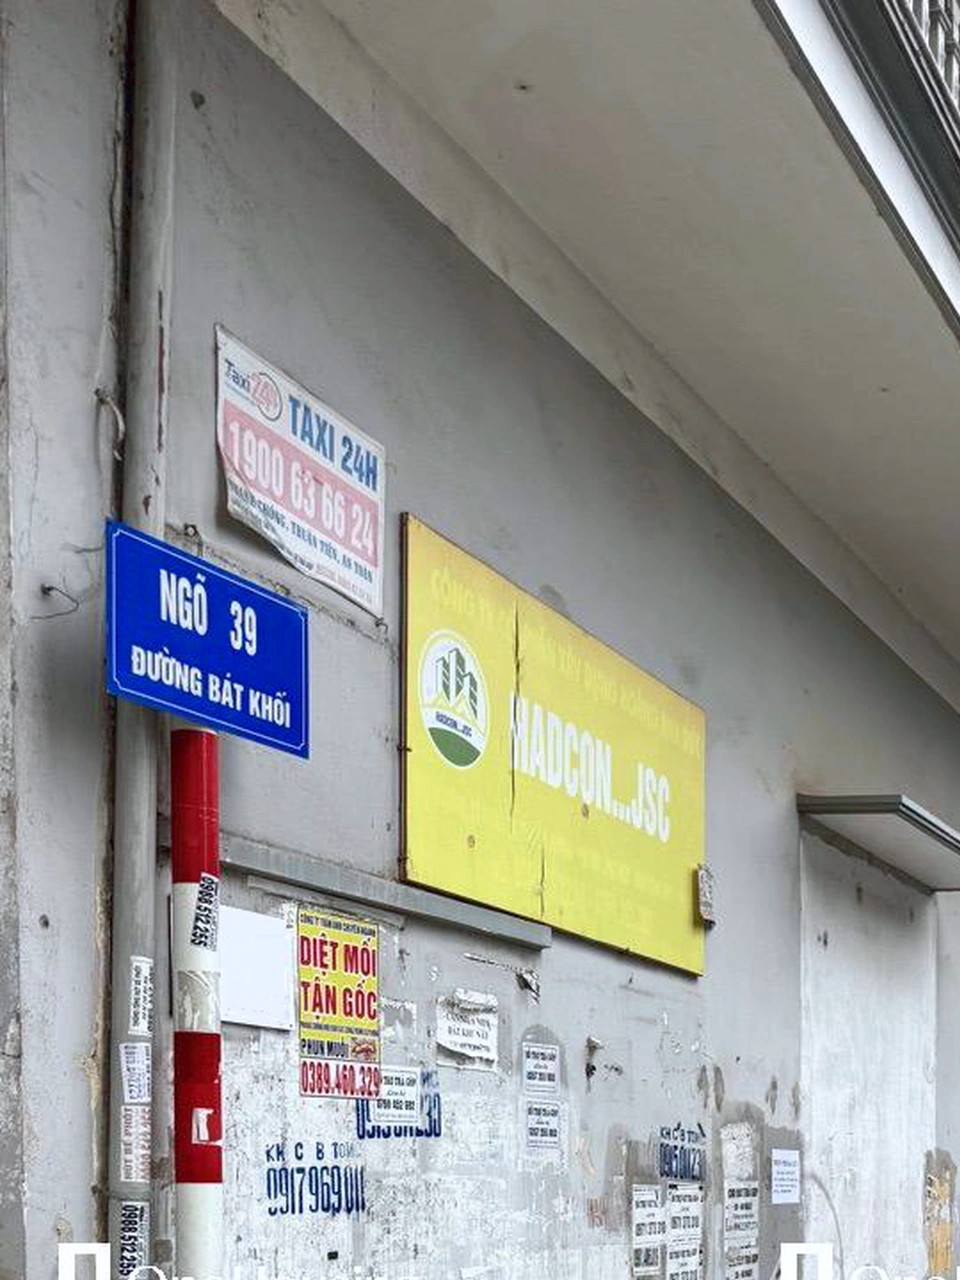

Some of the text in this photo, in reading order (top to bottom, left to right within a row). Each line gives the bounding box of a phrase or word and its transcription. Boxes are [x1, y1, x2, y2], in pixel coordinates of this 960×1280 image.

[288, 393, 378, 493] TAXI 24H
[229, 421, 285, 498] 1900
[291, 459, 316, 520] 63
[321, 482, 346, 539] 66
[351, 503, 374, 558] 24
[159, 567, 258, 657] NGÕ 39
[131, 644, 291, 728] ĐƯỜNG BÁT KHỐI
[300, 932, 377, 978] DIỆT MỐI
[300, 976, 378, 1022] TẬN GỐC
[300, 1038, 326, 1057] PHUN
